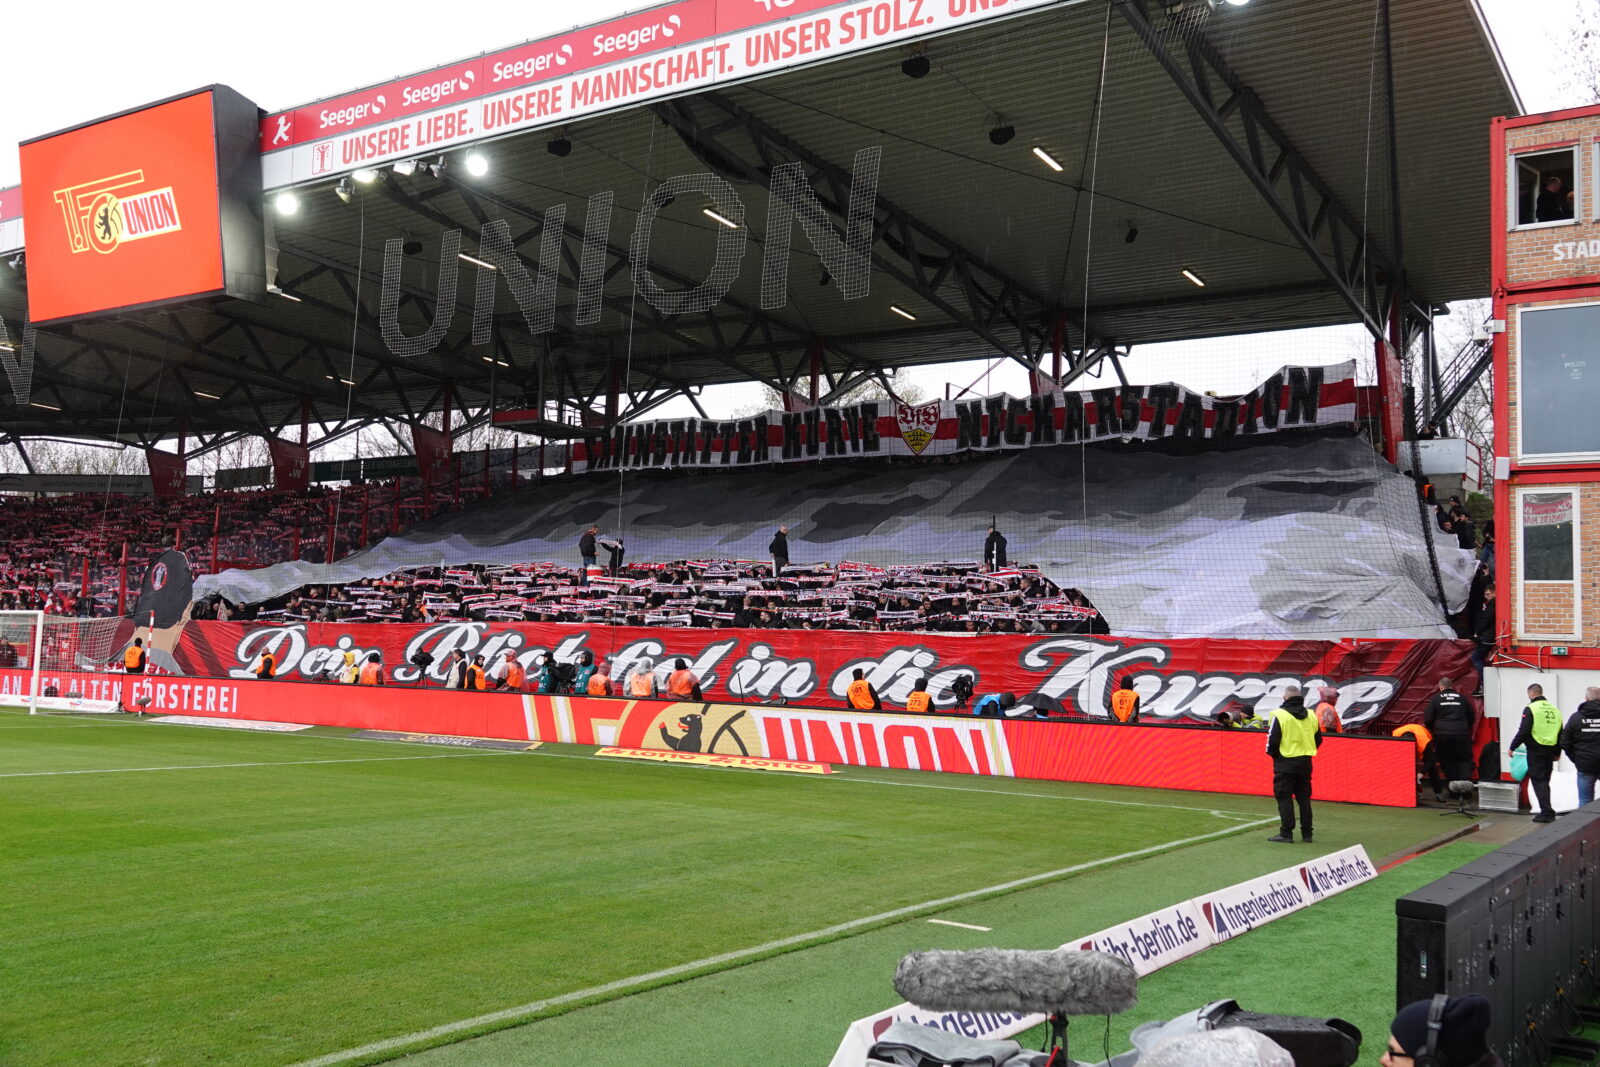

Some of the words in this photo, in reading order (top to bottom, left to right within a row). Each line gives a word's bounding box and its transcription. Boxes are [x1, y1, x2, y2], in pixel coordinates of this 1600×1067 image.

[593, 24, 660, 56] Seeger
[342, 124, 411, 164] UNSERE
[416, 109, 474, 147] LIEBE.
[483, 85, 563, 129] UNSERE
[571, 43, 734, 109] MANNSCHAFT.
[745, 18, 831, 67] UNSER
[840, 0, 934, 44] STOLZ.
[492, 52, 554, 82] Seeger
[402, 75, 457, 106] Seeger
[319, 102, 370, 128] Seeger
[122, 191, 178, 235] UNION
[379, 145, 883, 357] UNION
[782, 402, 880, 460] KURVE
[955, 367, 1324, 450] NECKARSTADION
[738, 646, 814, 698] in
[2, 675, 23, 695] AN
[132, 678, 238, 713] FÖRSTEREI
[1544, 711, 1556, 719] 23
[629, 750, 697, 760] LOTTO
[739, 759, 814, 770] LOTTO
[1219, 882, 1304, 930] Ingenieurbüro
[1314, 855, 1369, 893] ihr-berlin.de
